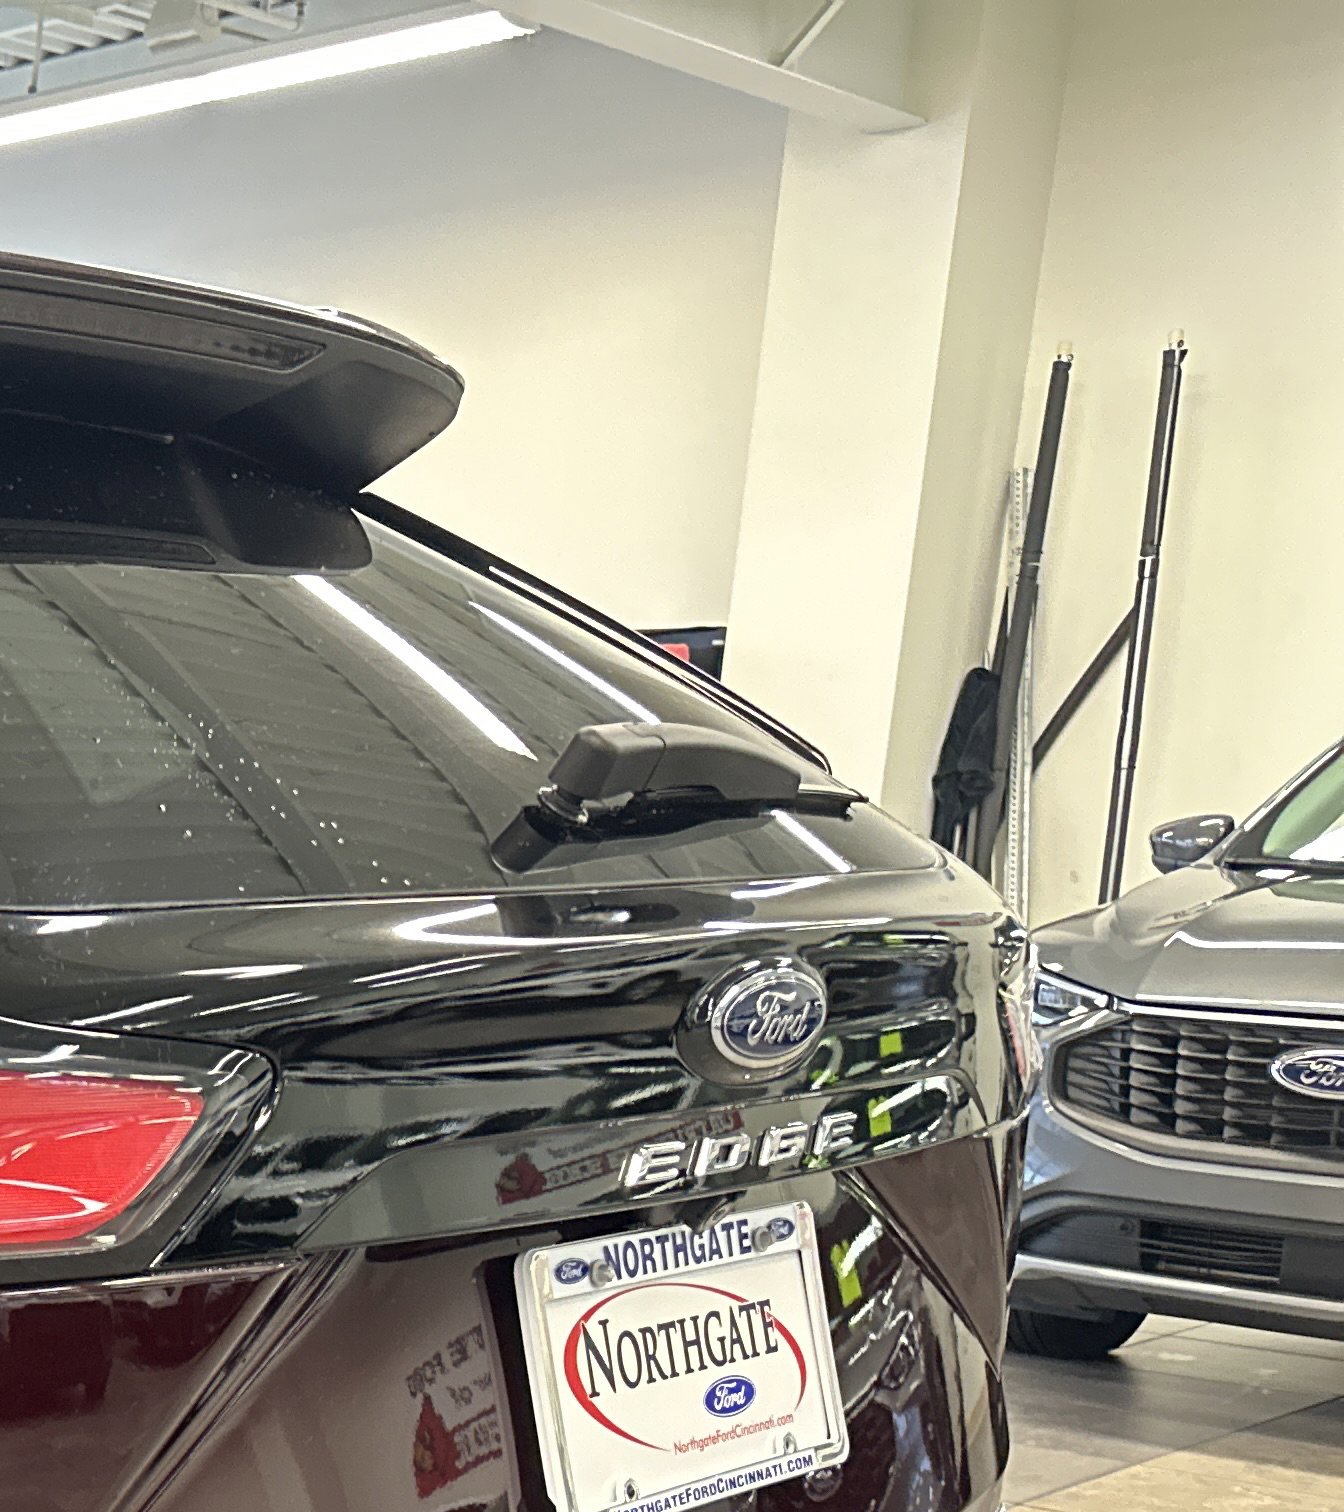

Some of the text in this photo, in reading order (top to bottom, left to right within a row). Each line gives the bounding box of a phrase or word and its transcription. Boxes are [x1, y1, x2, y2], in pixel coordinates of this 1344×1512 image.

[747, 991, 810, 1046] Ford
[622, 1111, 857, 1187] EDGE
[604, 1219, 752, 1281] NORTHGATE
[581, 1299, 779, 1398] NORTHGATE
[714, 1382, 747, 1410] Ford
[673, 1413, 794, 1455] NorthgateFordCincinnati.com
